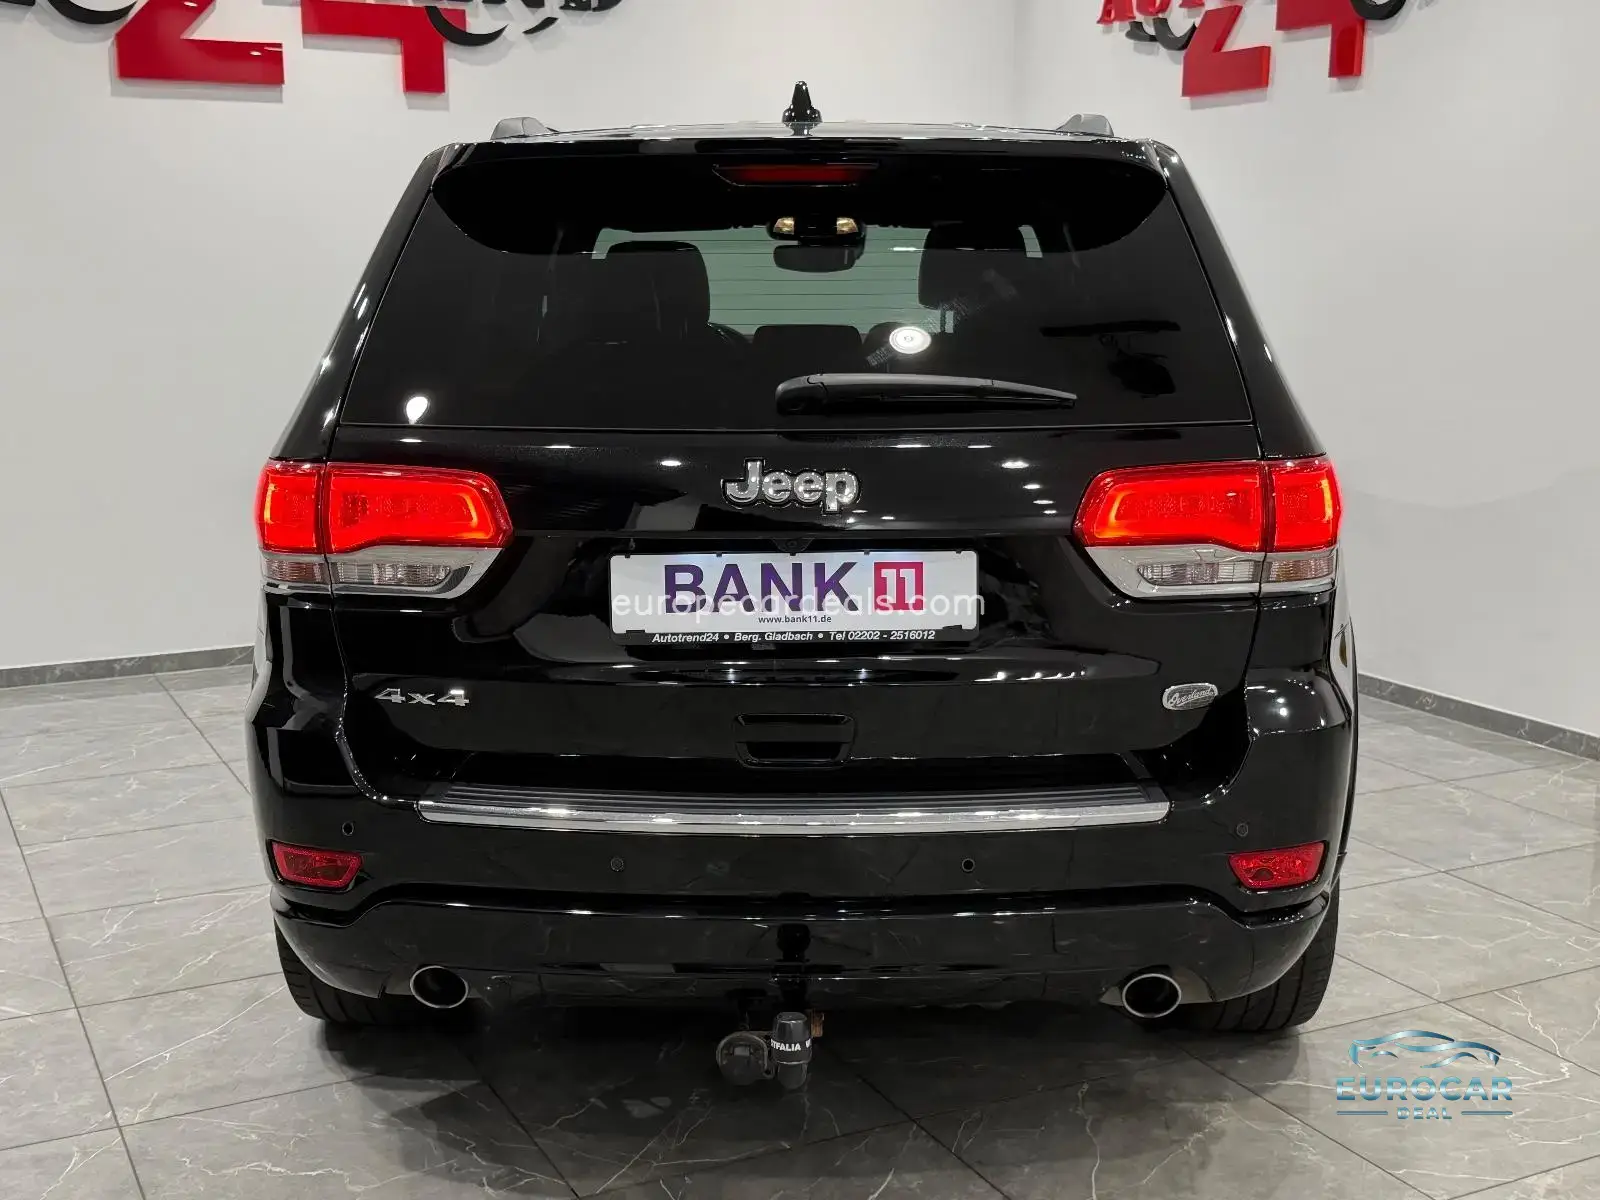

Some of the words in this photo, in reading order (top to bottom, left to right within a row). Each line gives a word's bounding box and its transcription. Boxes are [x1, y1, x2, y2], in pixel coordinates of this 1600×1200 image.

[723, 459, 861, 513] Jeep
[663, 561, 859, 613] BANK
[879, 567, 919, 607] 11
[758, 614, 832, 624] www.bank11.de
[652, 632, 720, 643] Autotrend24
[733, 632, 762, 643] Berg.
[764, 631, 813, 641] Gladbach
[829, 630, 846, 641] Tel
[847, 630, 881, 640] 02202
[889, 630, 936, 640] 2516012
